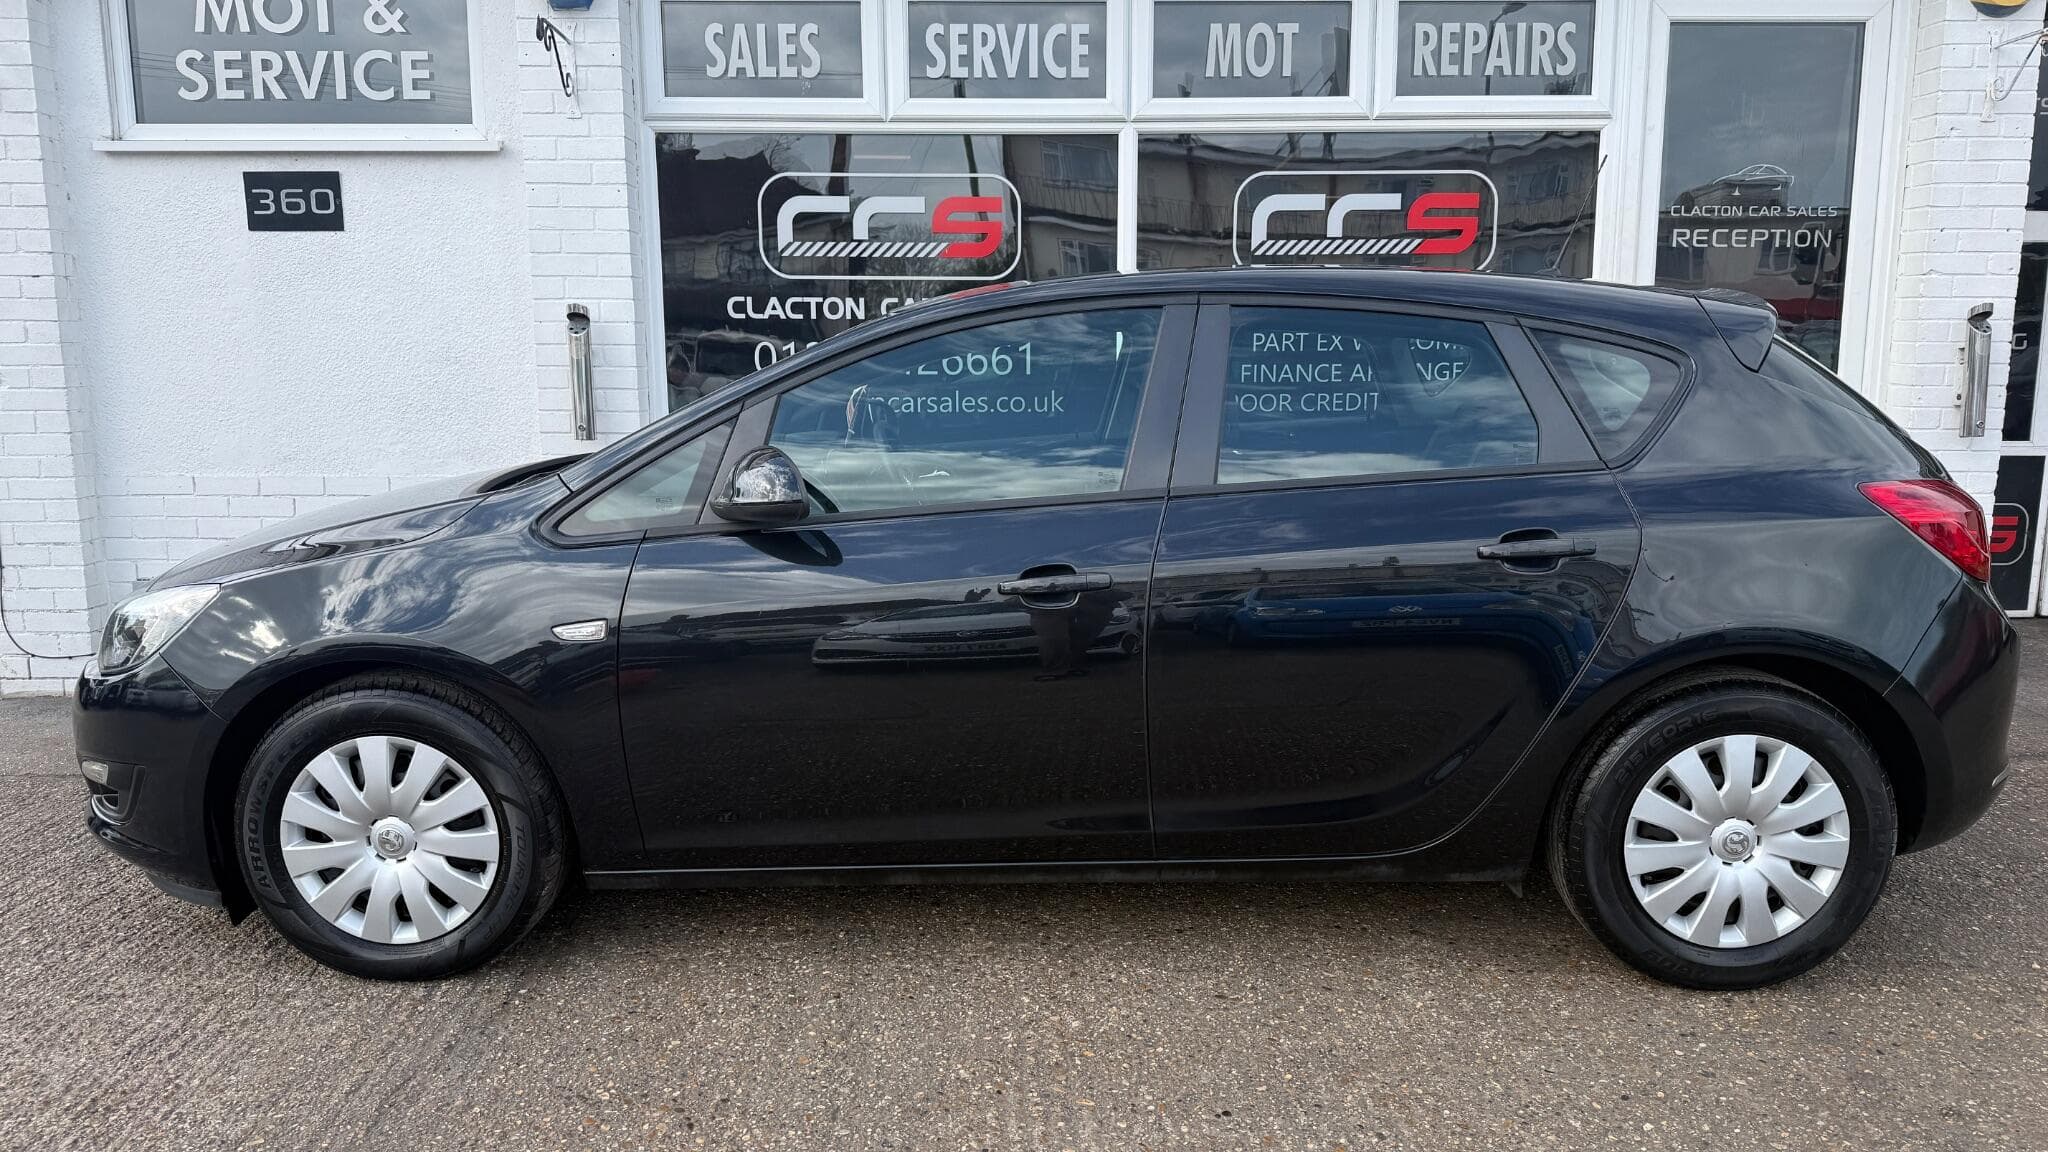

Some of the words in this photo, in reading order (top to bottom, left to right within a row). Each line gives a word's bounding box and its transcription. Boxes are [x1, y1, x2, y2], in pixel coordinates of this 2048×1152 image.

[194, 0, 331, 34] MOT
[362, 0, 407, 34] &
[704, 23, 822, 79] SALES
[925, 23, 1090, 79] SERVICE
[1205, 23, 1299, 78] MOT
[1413, 22, 1577, 77] REPAIRS
[175, 49, 431, 101] SERVICE
[252, 189, 336, 215] 360
[1670, 205, 1743, 217] CLACTON
[1748, 205, 1782, 217] CAR
[1786, 206, 1838, 217] SALES
[1672, 228, 1832, 248] RECEPTION
[727, 296, 866, 320] CLACTON
[1253, 332, 1309, 352] PART
[1317, 333, 1344, 351] EX
[1241, 363, 1343, 383] FINANCE
[1235, 393, 1293, 412] OOR
[1300, 392, 1379, 412] CREDIT
